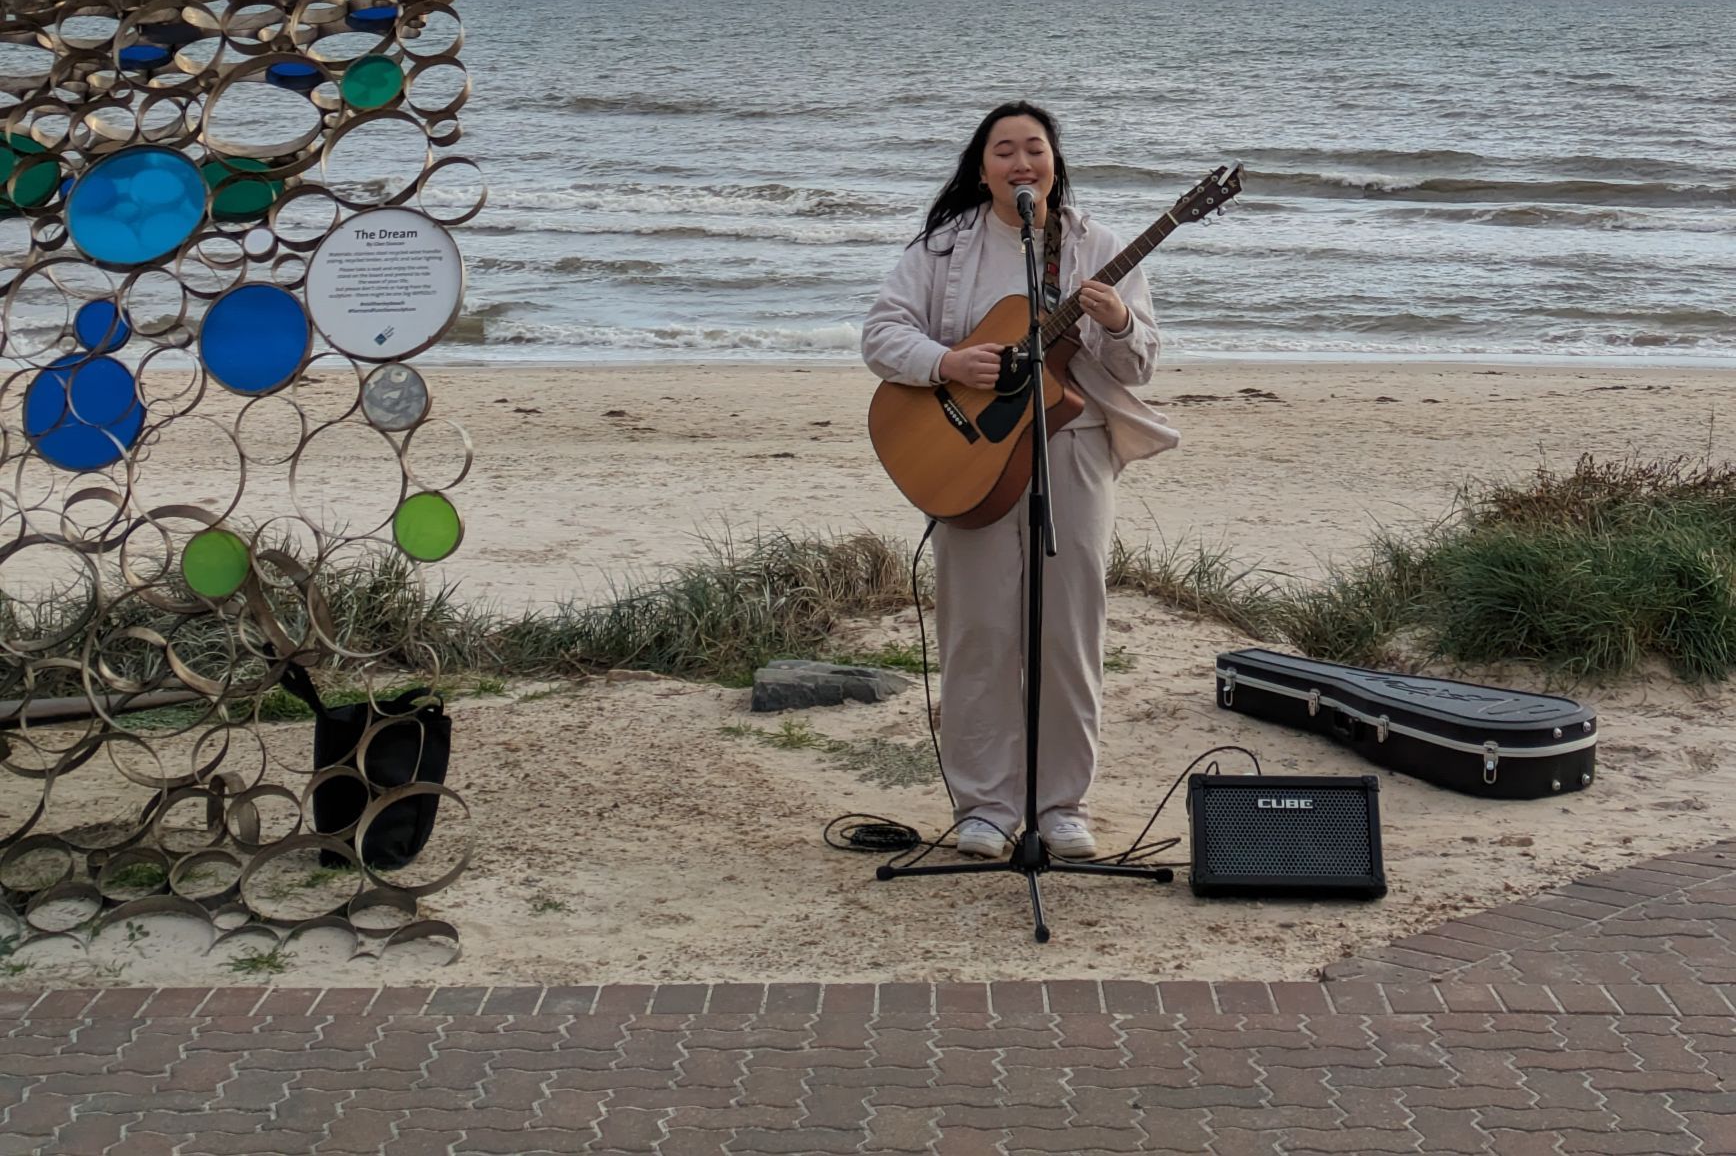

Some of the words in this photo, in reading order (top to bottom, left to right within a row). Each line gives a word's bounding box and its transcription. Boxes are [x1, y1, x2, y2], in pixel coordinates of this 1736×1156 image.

[354, 229, 376, 240] The
[378, 229, 418, 240] Dream
[1257, 799, 1313, 808] CUBE
